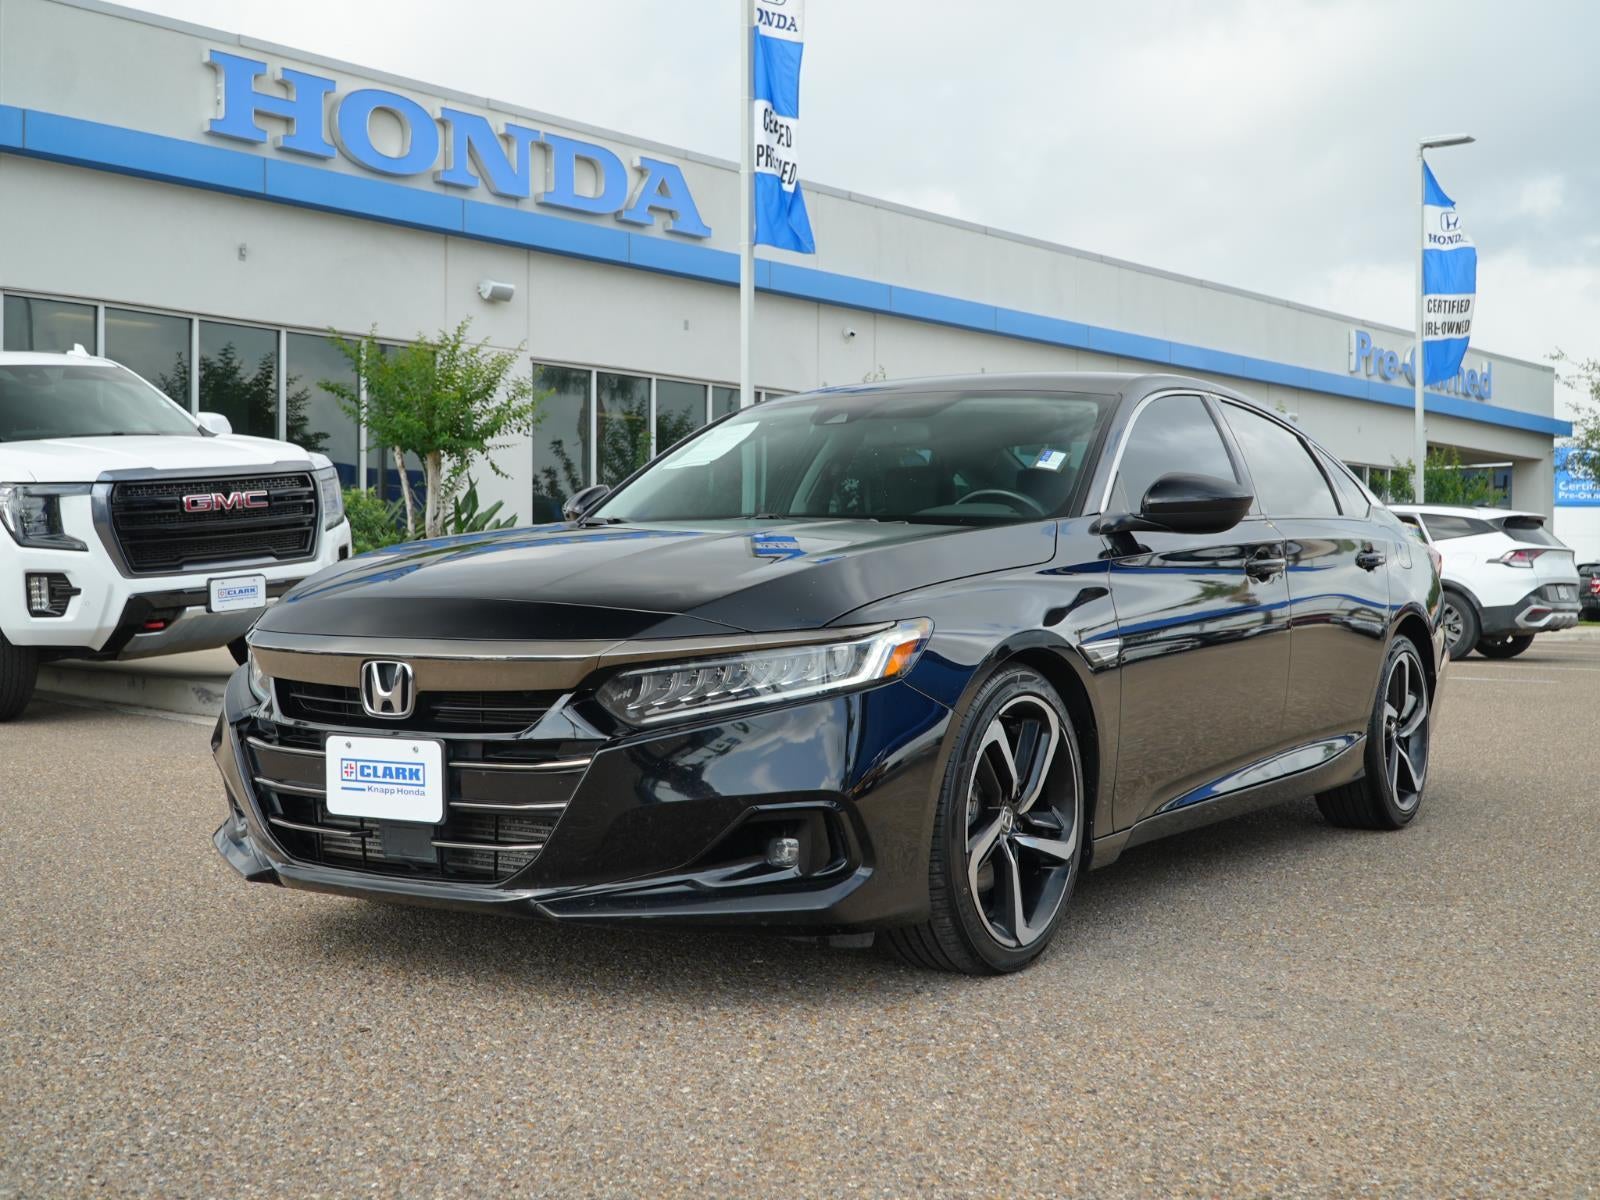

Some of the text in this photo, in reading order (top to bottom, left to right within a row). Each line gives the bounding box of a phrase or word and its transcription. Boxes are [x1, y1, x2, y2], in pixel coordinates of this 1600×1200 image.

[204, 50, 711, 238] HONDA
[1428, 233, 1466, 245] HOND
[1427, 299, 1471, 314] CERTIFIED
[182, 490, 269, 512] GMC
[359, 765, 421, 781] CLARK
[367, 785, 426, 797] Knapp Honda
